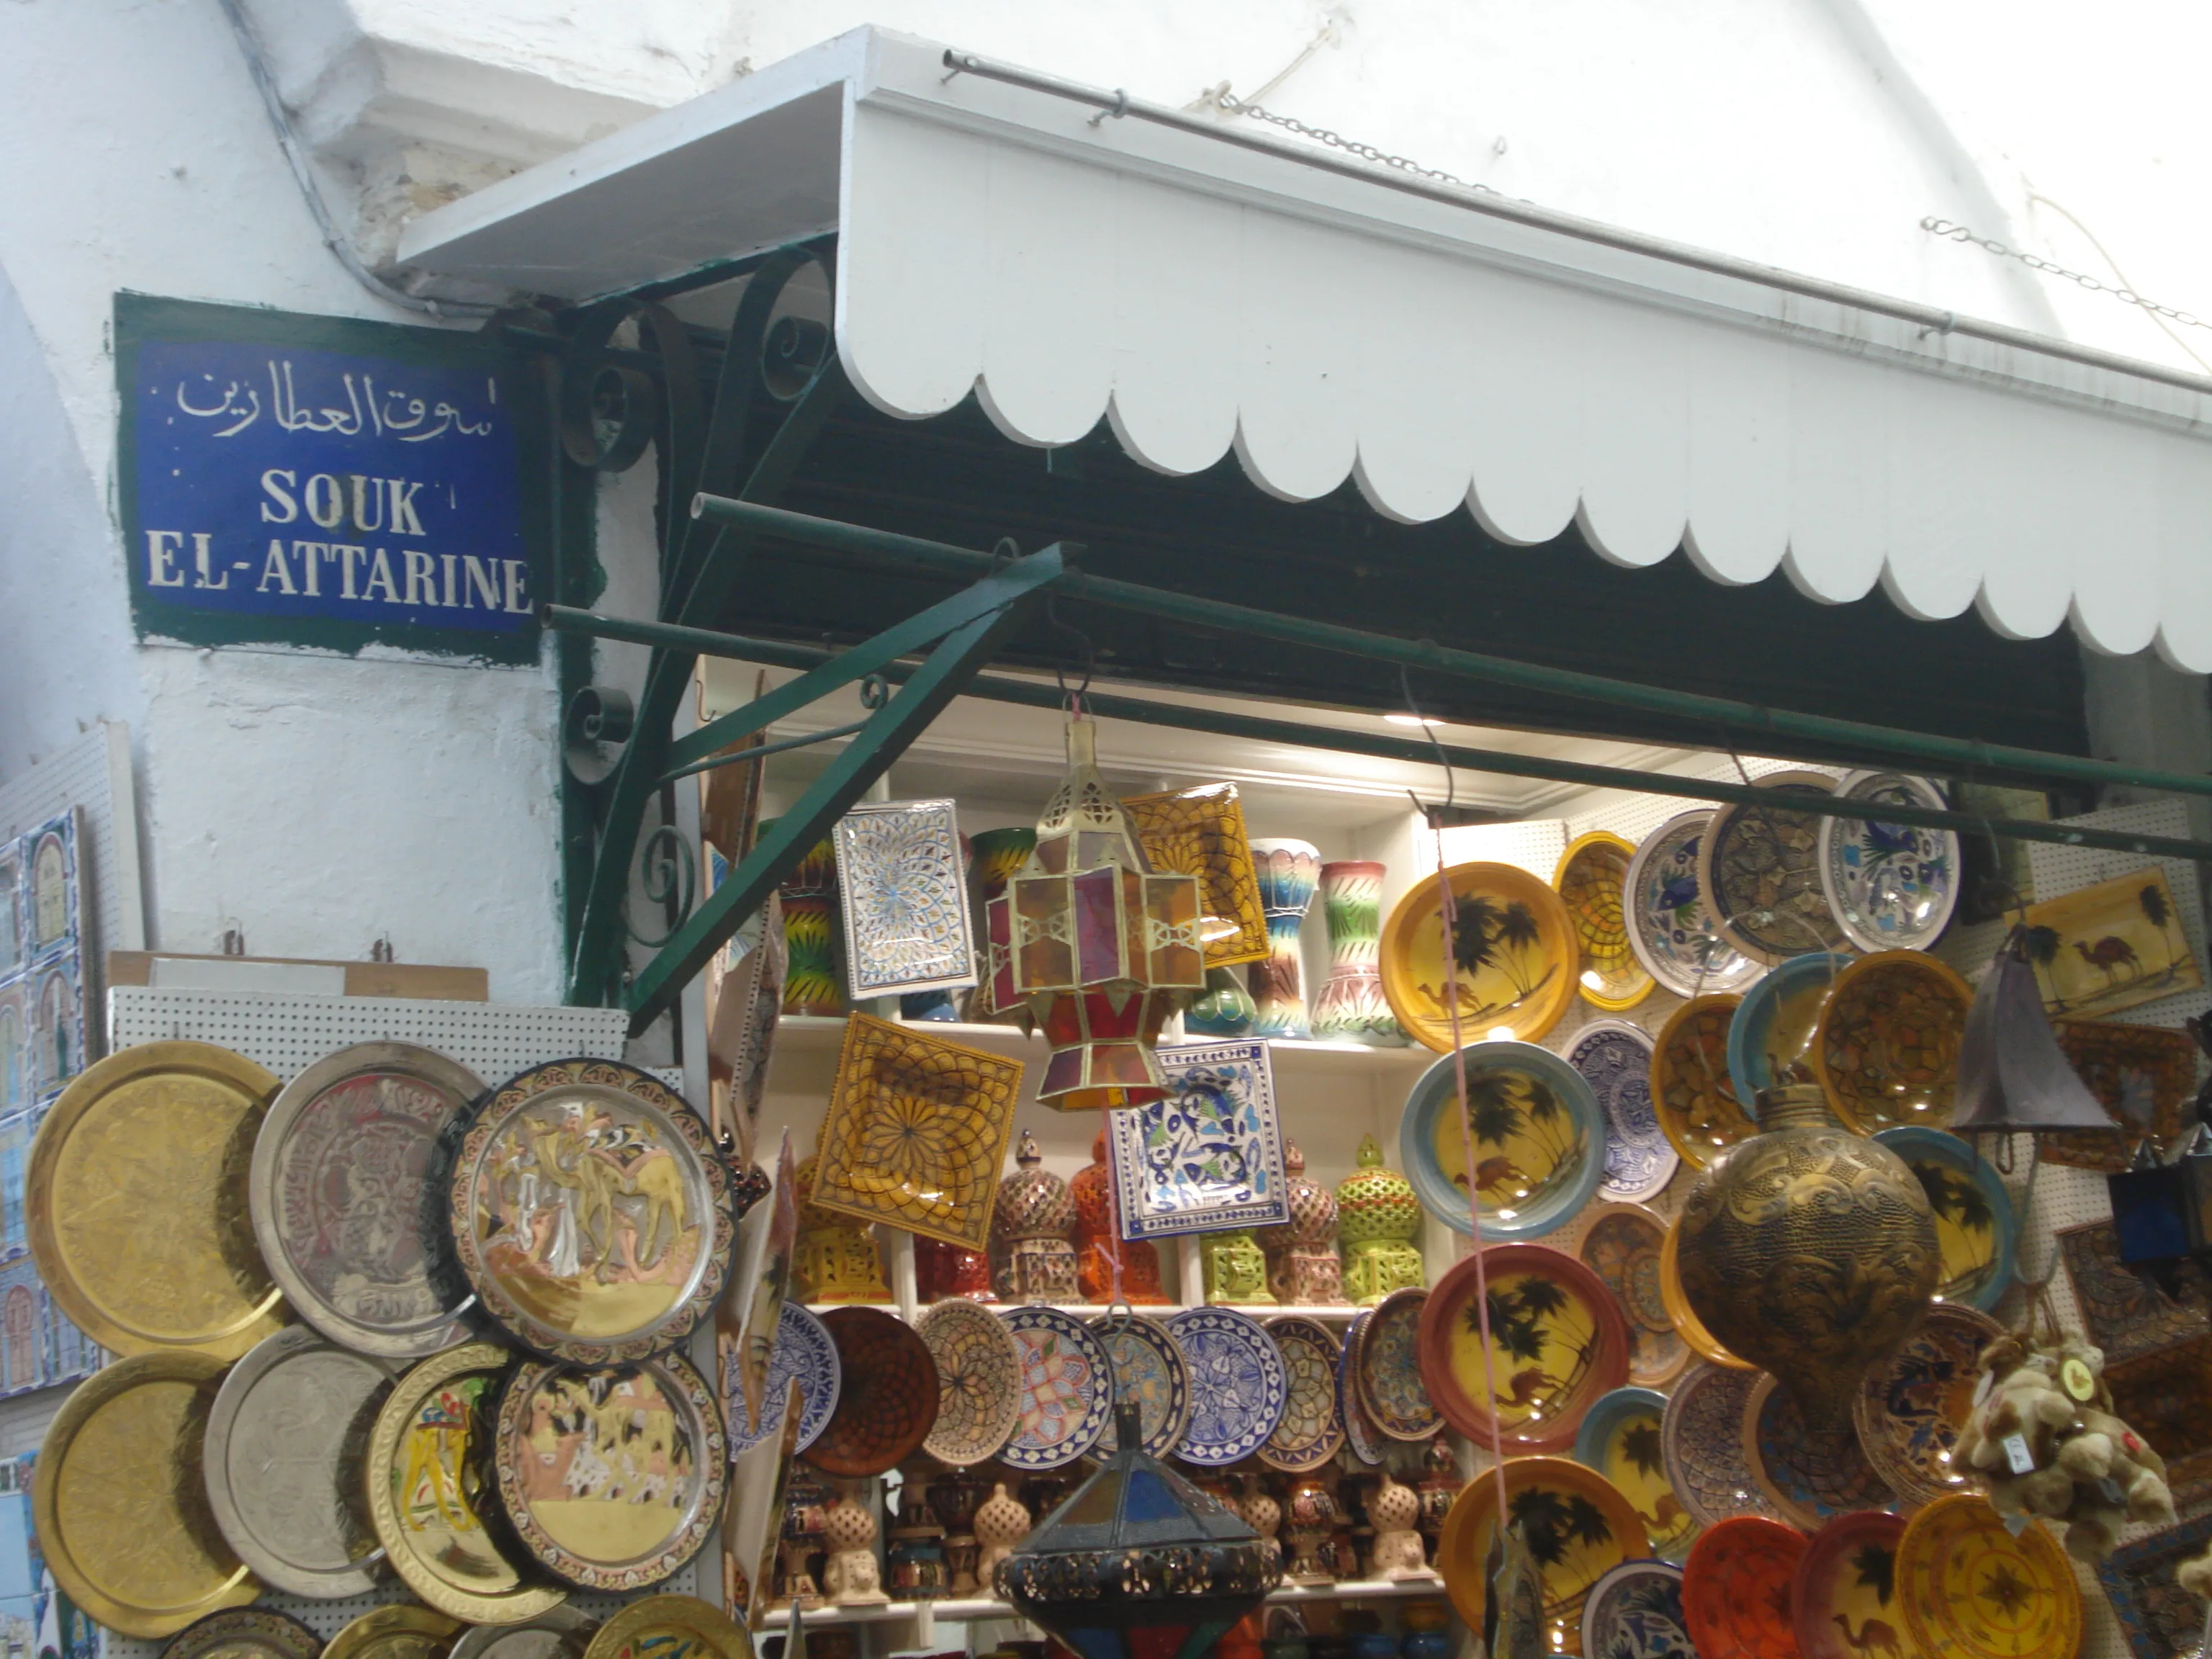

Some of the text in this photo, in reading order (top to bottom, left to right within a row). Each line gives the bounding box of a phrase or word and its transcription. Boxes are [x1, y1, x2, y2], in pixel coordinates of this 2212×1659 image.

[383, 390, 493, 441] سوق
[260, 468, 427, 536] SOUK
[145, 529, 534, 615] EL-ATTARINE
